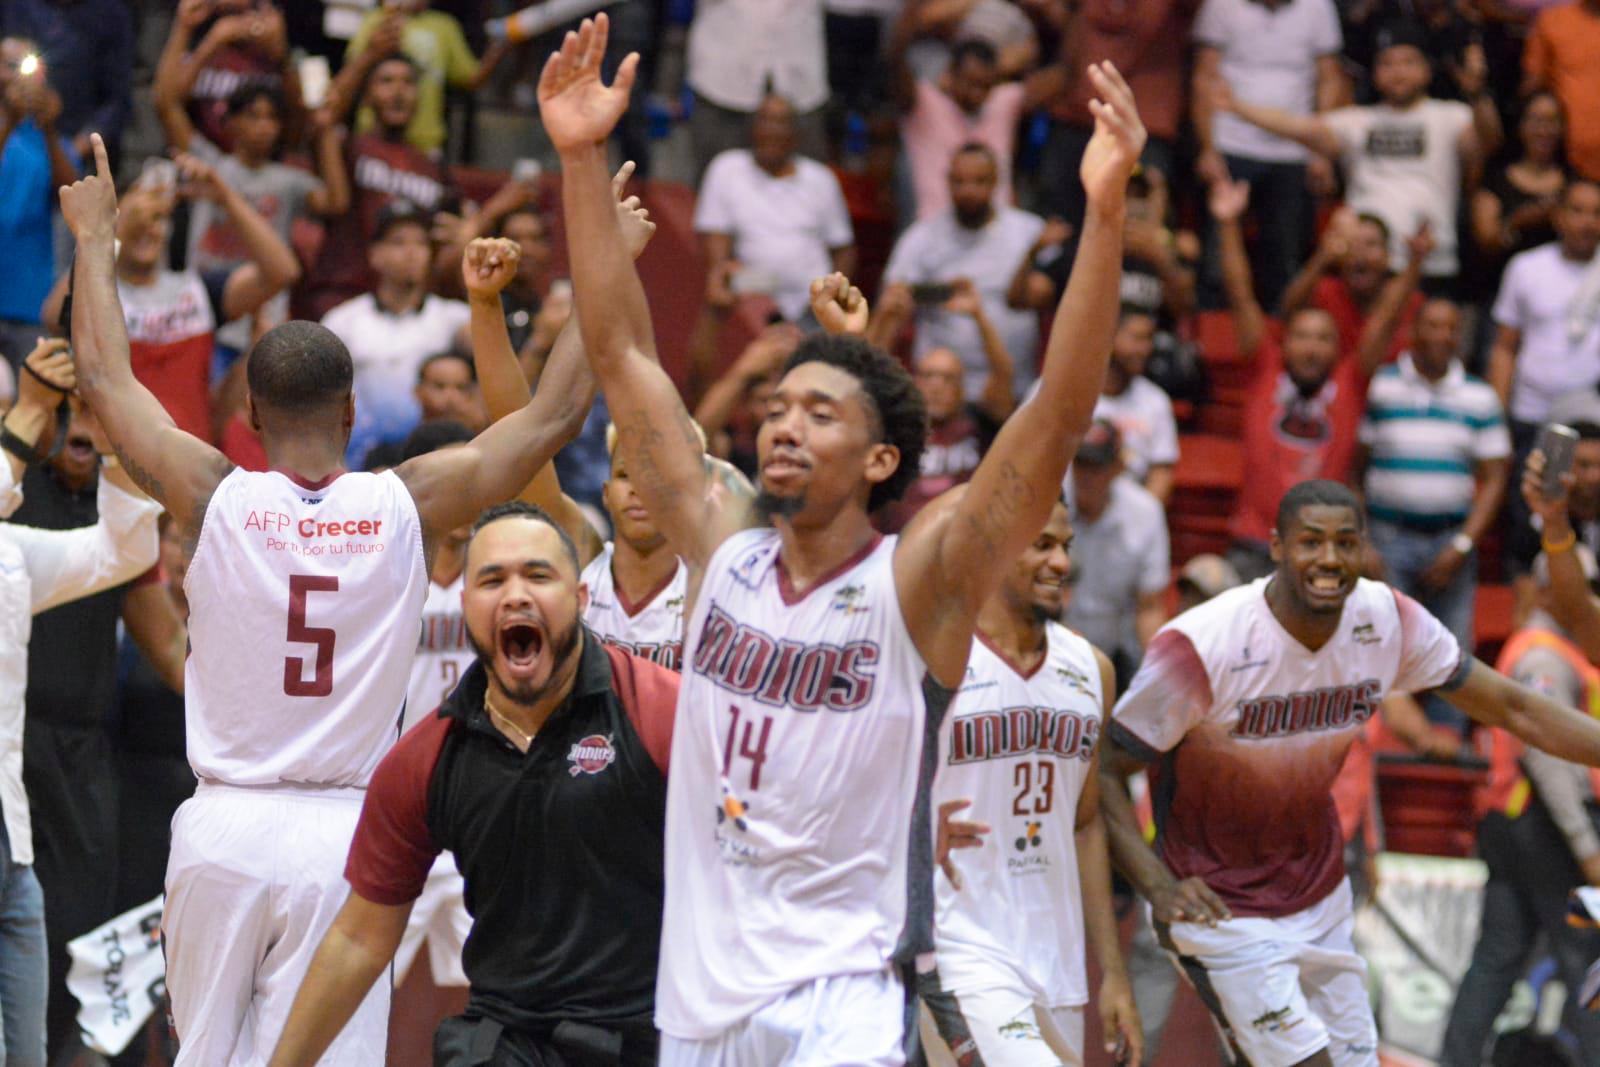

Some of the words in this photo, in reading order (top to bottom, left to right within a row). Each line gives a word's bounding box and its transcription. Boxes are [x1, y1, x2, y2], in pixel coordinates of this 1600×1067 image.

[244, 510, 290, 532] AFP
[298, 518, 382, 538] Crecer
[266, 537, 287, 551] Por
[329, 543, 342, 554] tu
[346, 541, 385, 554] futuro
[284, 574, 338, 696] 5
[721, 703, 773, 791] 14
[1012, 760, 1055, 816] 23
